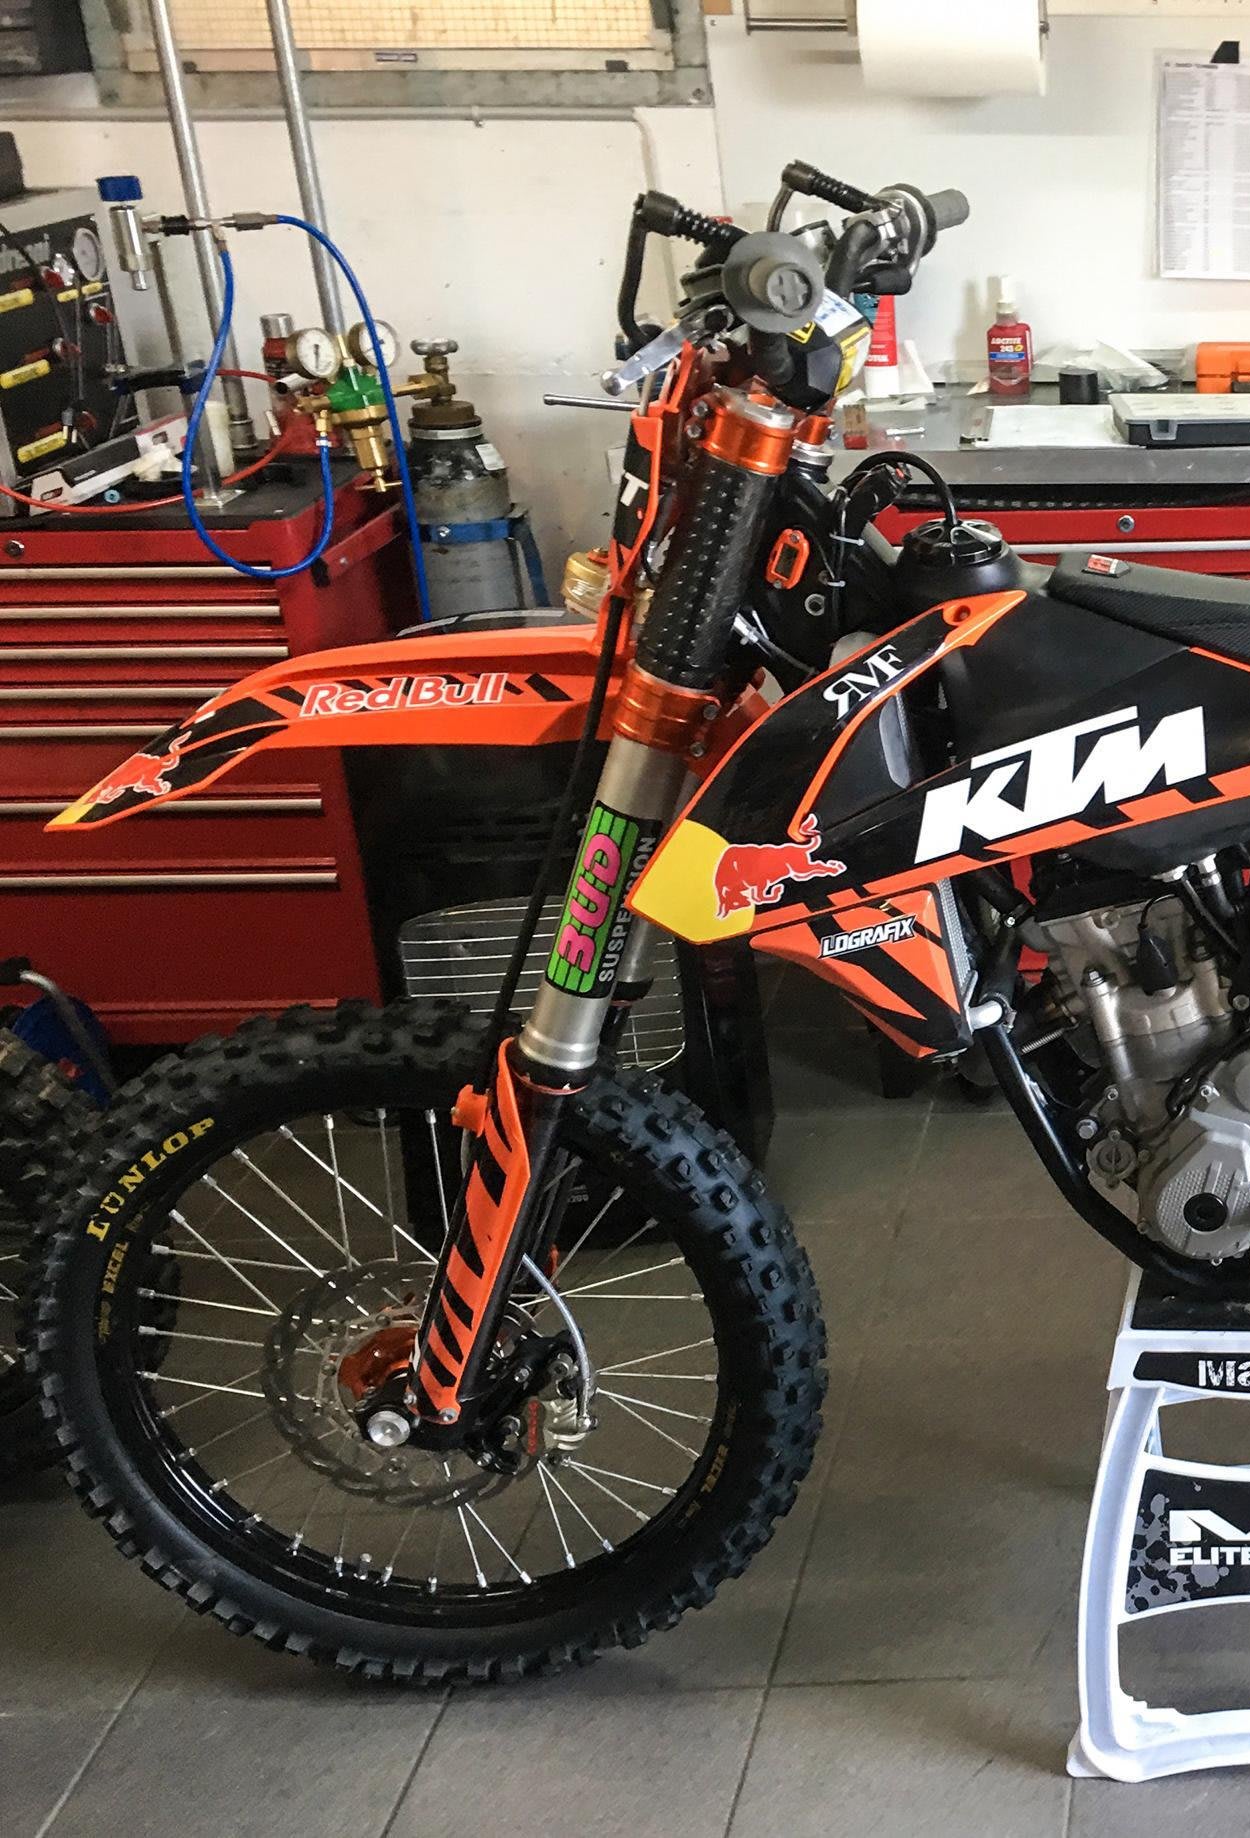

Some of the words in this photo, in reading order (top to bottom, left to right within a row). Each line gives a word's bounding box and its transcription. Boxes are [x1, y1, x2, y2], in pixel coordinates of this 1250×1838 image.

[299, 677, 406, 718] Red
[404, 672, 509, 708] Bull
[913, 705, 1208, 865] KTM
[557, 832, 622, 974] BUD
[598, 836, 657, 983] SUSPEION
[821, 917, 913, 957] LOGRAFIX
[101, 1240, 130, 1295] EXCEL
